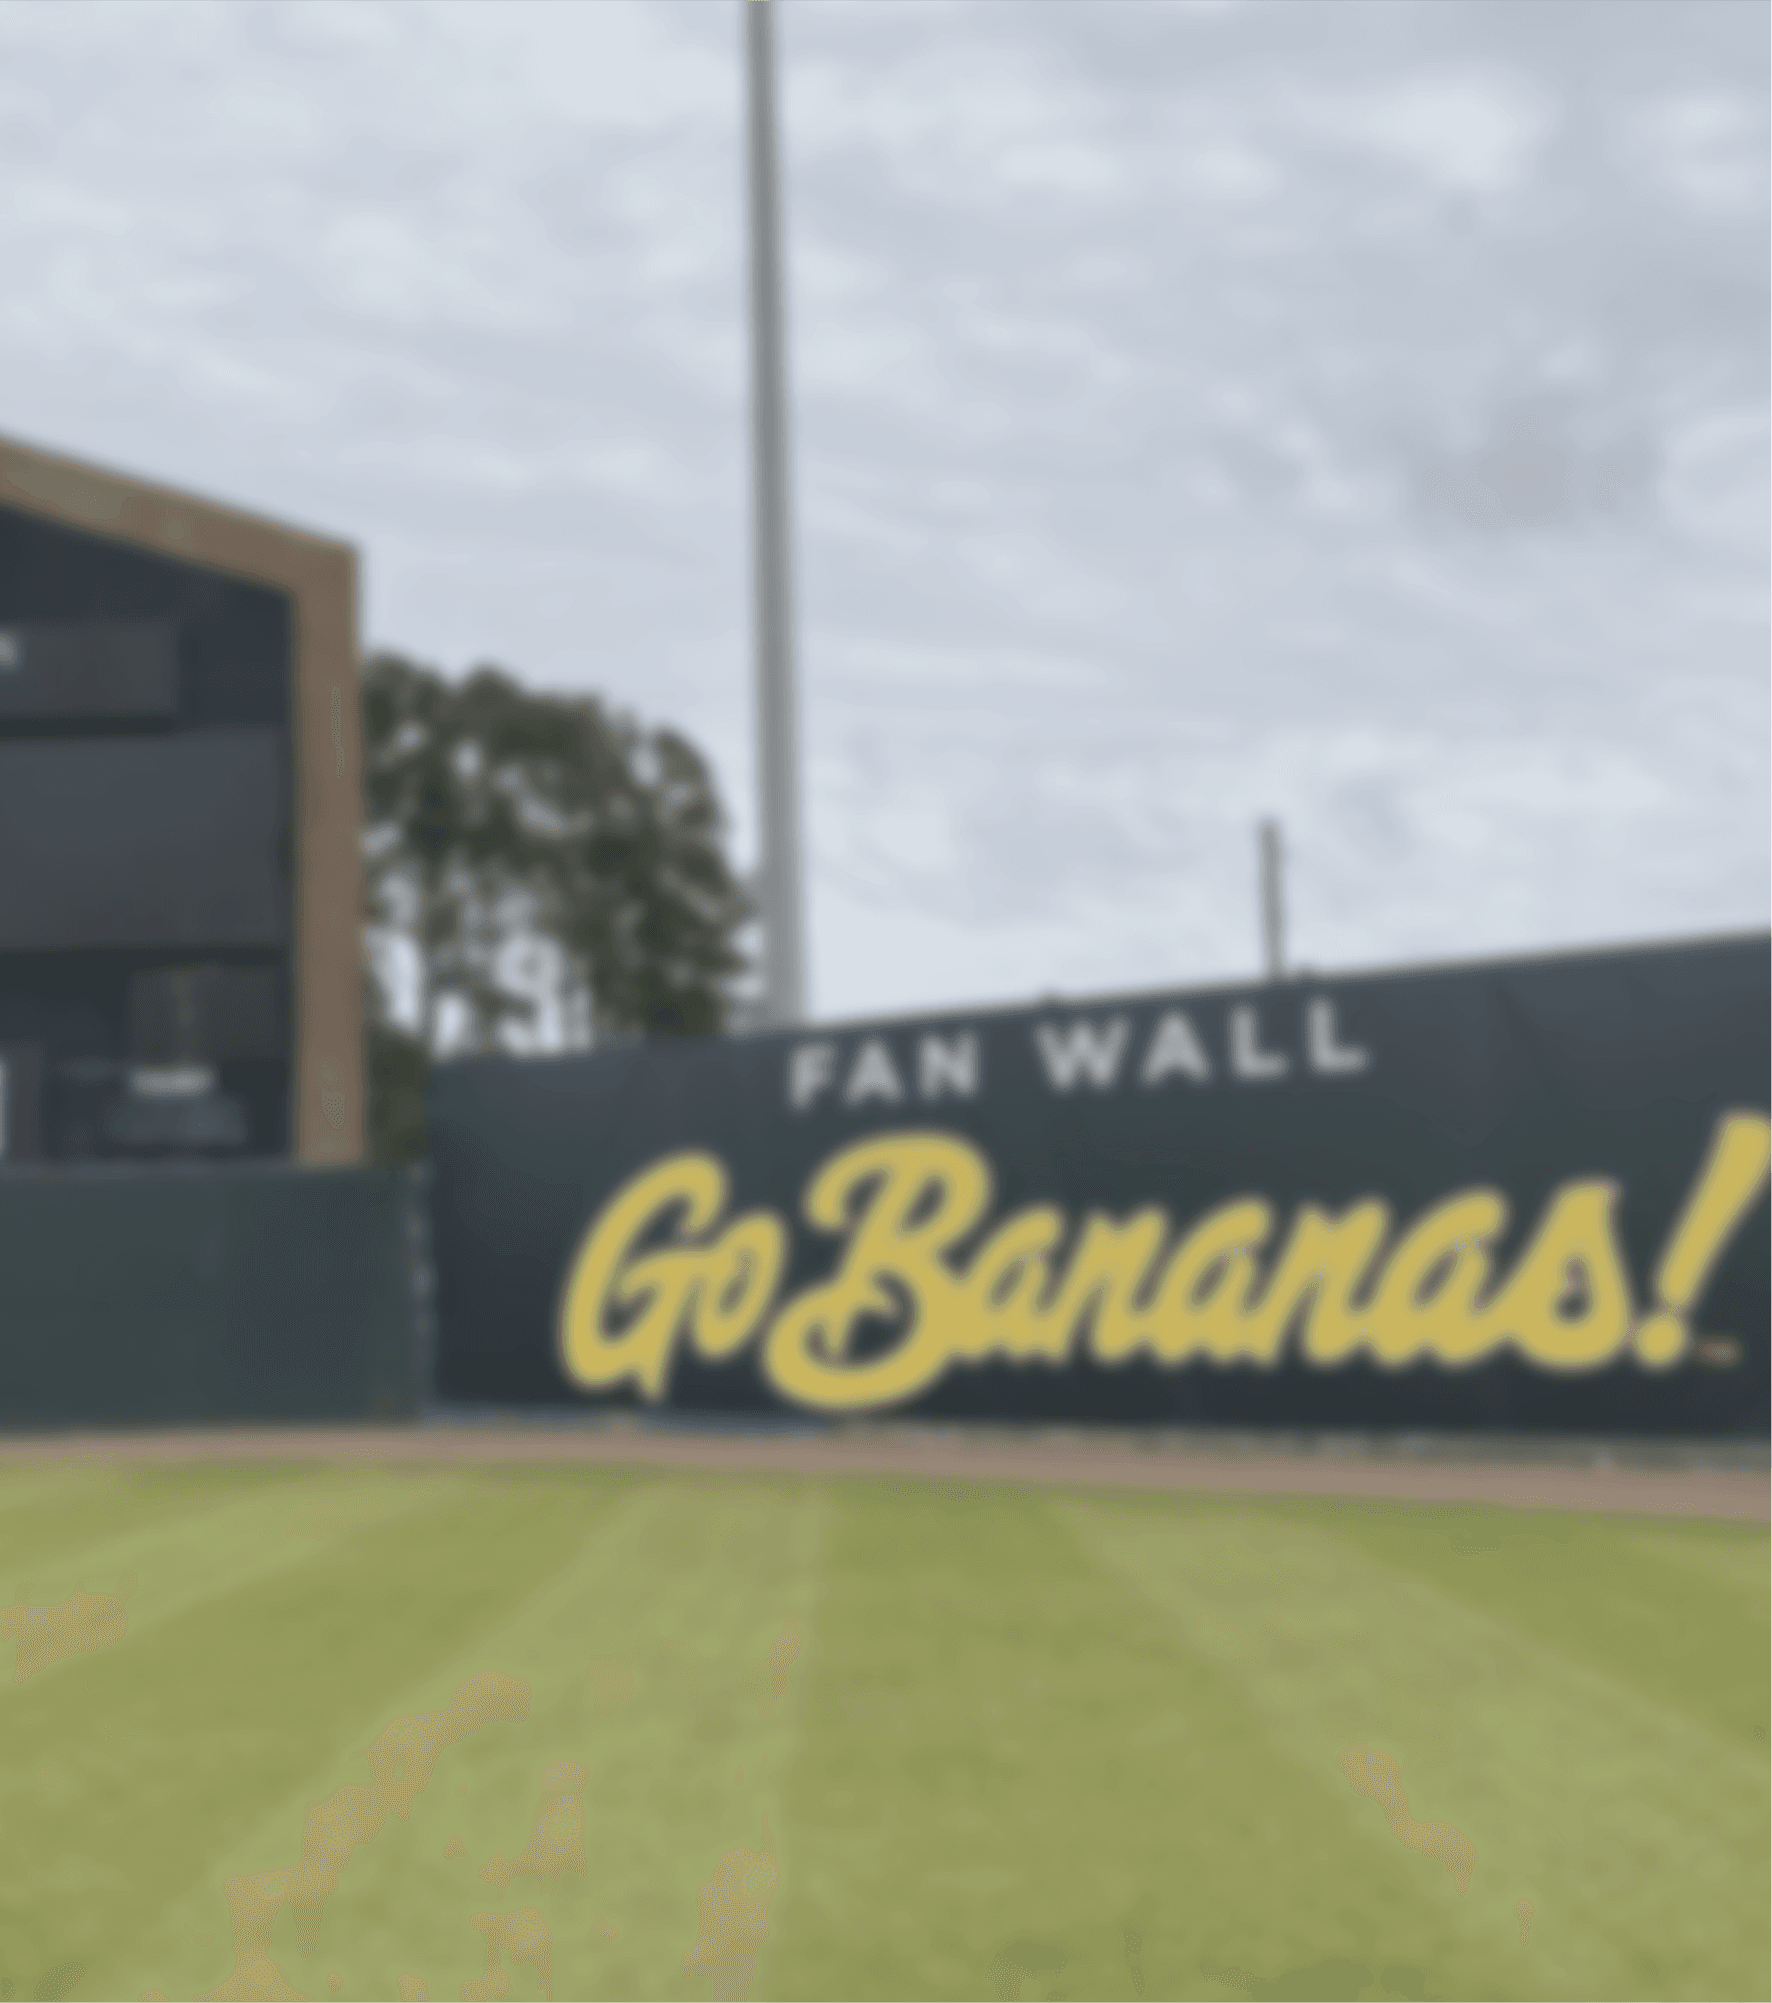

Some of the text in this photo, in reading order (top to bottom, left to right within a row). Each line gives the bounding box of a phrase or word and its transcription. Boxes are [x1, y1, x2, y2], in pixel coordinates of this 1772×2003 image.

[790, 1000, 1370, 1106] FAN WALL
[563, 1112, 1772, 1408] Go Bananas!
